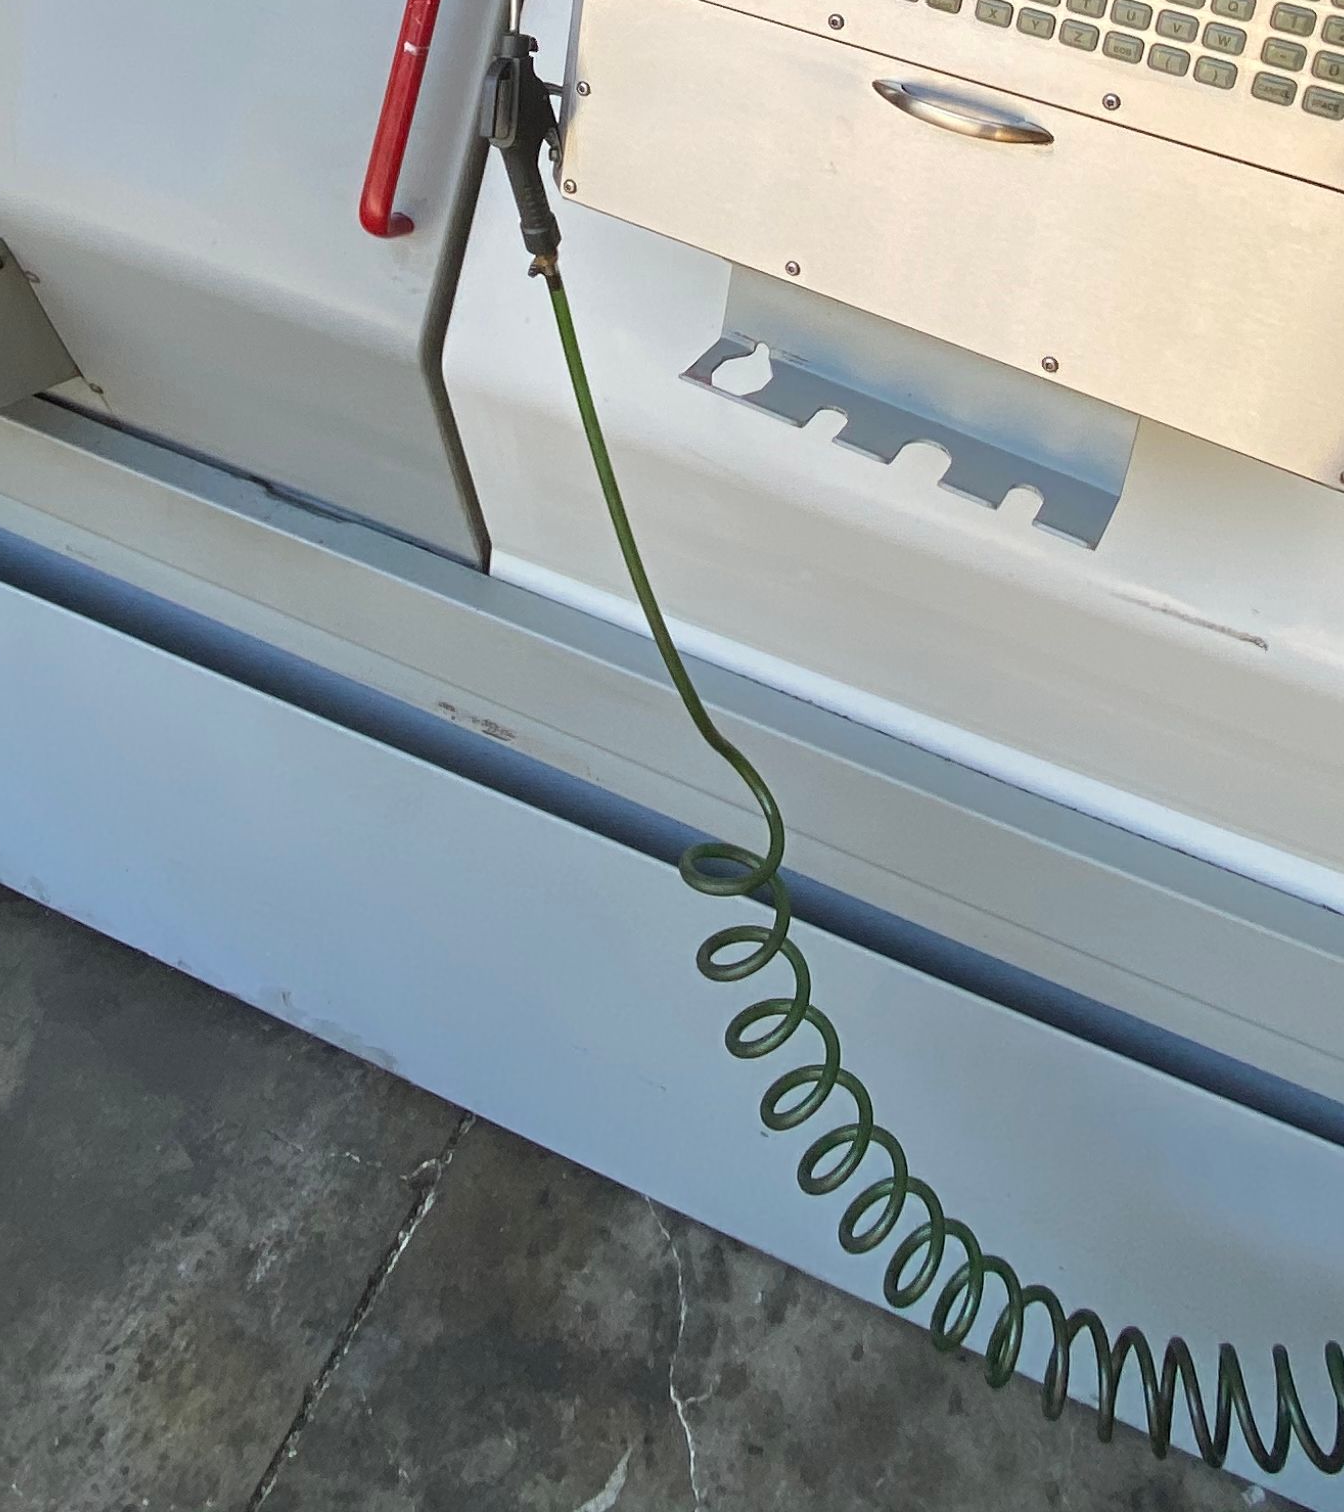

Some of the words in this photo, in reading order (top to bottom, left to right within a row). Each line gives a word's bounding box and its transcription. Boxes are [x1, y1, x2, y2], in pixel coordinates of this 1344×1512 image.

[987, 8, 998, 19] X
[1126, 10, 1135, 22] U
[1031, 19, 1040, 30] Y
[1172, 23, 1181, 34] V
[1073, 31, 1083, 42] Z
[1217, 34, 1231, 47] W
[1329, 64, 1339, 77] 0
